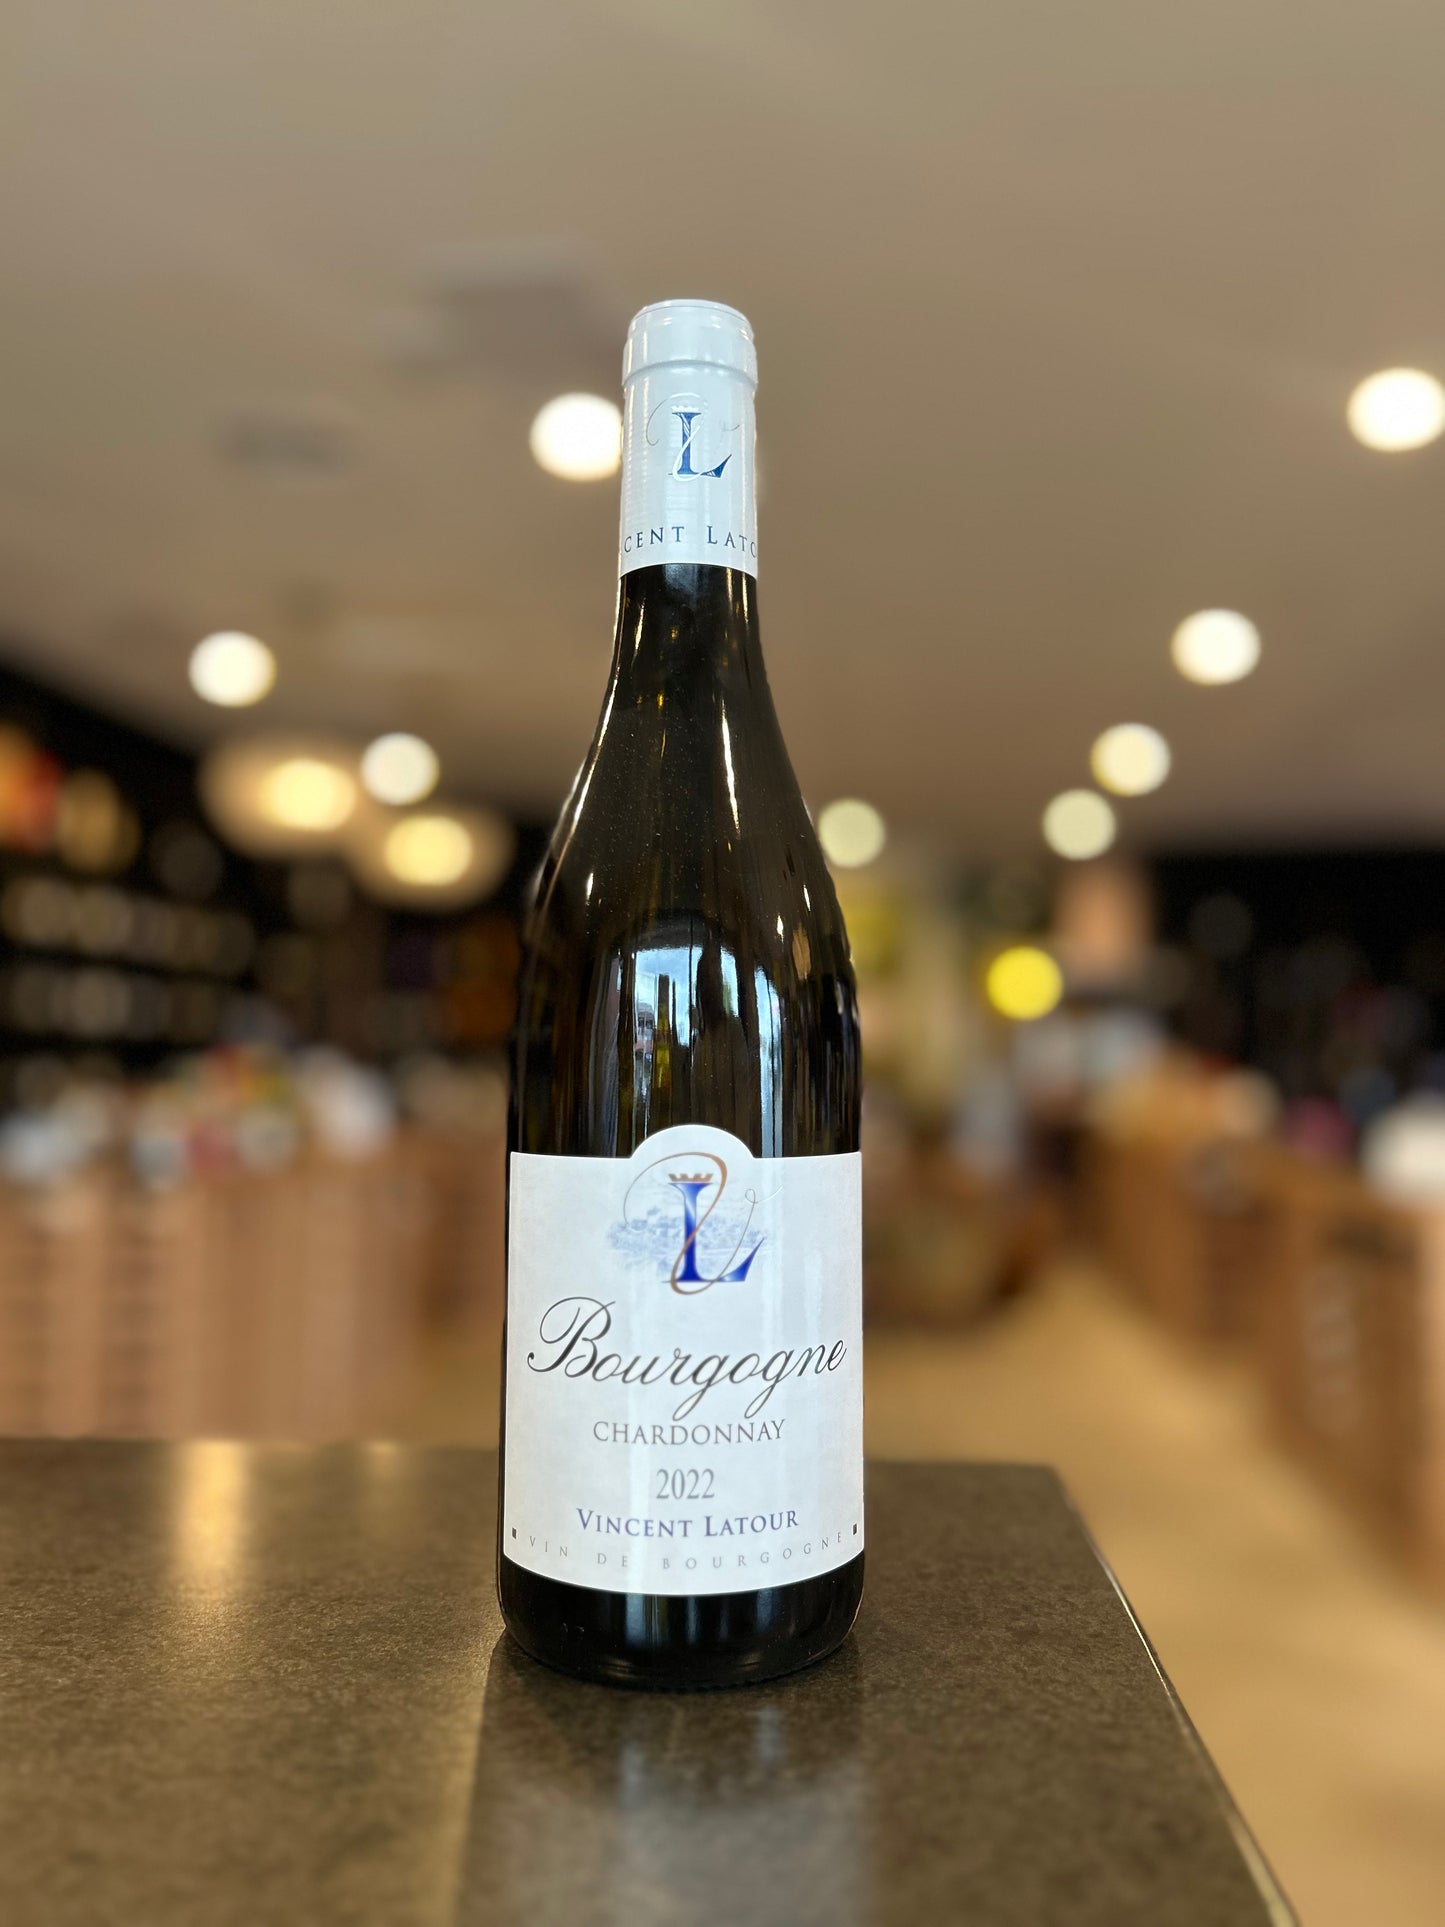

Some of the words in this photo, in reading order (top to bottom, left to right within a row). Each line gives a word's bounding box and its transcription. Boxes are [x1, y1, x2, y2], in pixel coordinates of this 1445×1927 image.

[624, 526, 685, 553] CENT
[526, 1296, 847, 1421] Bourgogne
[593, 1418, 786, 1446] CHARDONNAY
[655, 1468, 716, 1500] 2022
[576, 1508, 693, 1538] VINCENT
[703, 1510, 800, 1538] LATOUR
[528, 1535, 569, 1557] VIN
[597, 1553, 629, 1568] DE
[662, 1531, 843, 1570] BOURGOGNE
